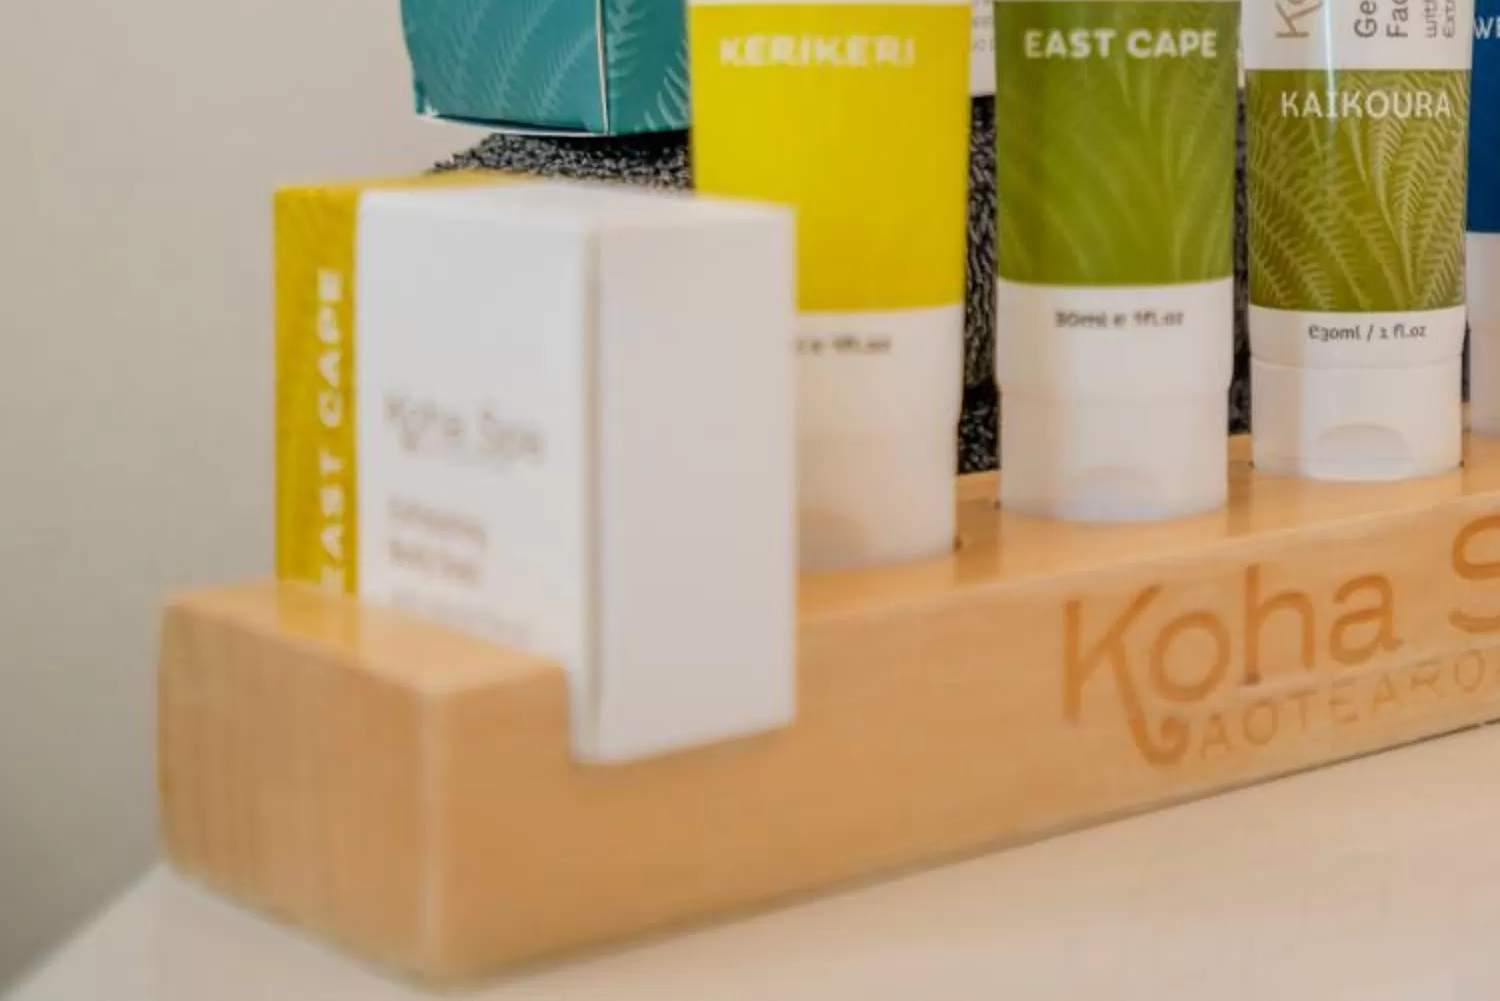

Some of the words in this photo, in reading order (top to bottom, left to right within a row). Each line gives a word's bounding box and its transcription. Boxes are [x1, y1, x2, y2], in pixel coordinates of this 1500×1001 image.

[719, 34, 917, 68] KERIKERI
[1024, 28, 1116, 59] EAST
[1126, 28, 1218, 59] CAPE
[1280, 89, 1451, 120] KAIKOURA
[317, 267, 345, 429] CAPE
[1393, 324, 1427, 340] fl.oz
[1061, 563, 1404, 767] Koha
